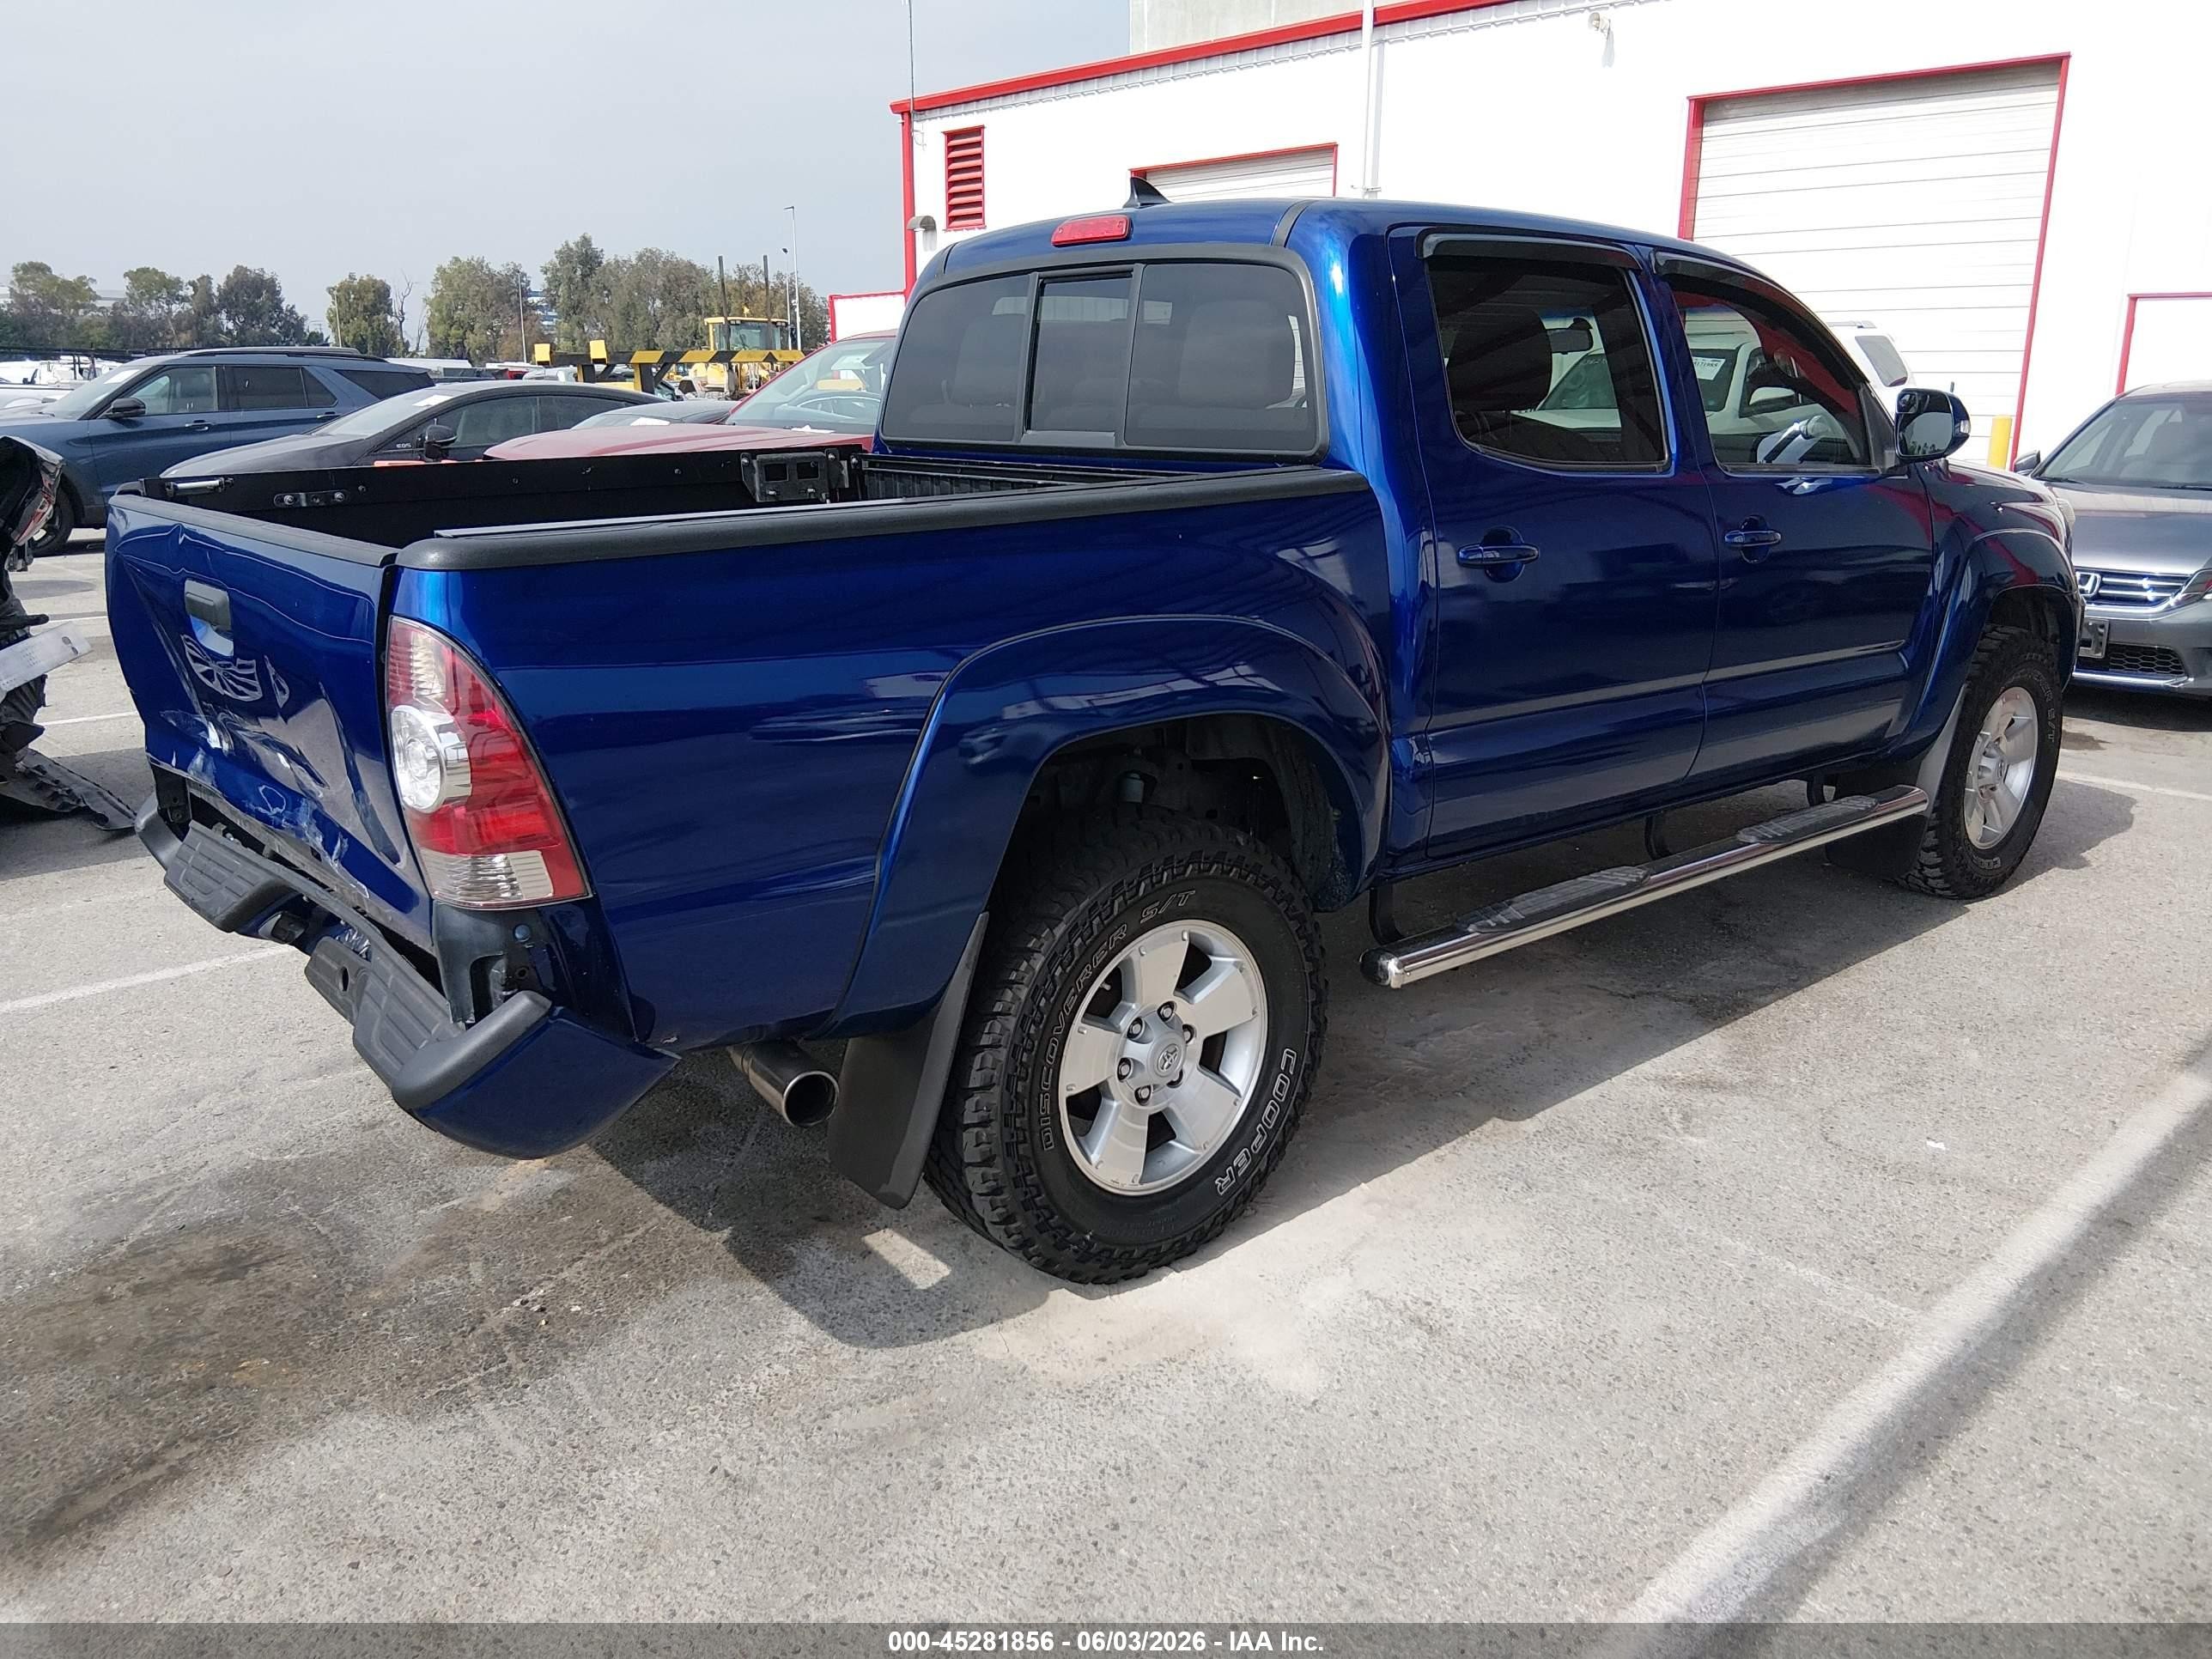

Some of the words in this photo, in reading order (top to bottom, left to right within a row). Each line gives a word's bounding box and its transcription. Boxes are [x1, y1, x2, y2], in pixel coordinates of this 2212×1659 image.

[1039, 923, 1128, 1152] DISCOVERER
[1139, 890, 1196, 924] S/T
[1214, 1048, 1297, 1196] COOPER
